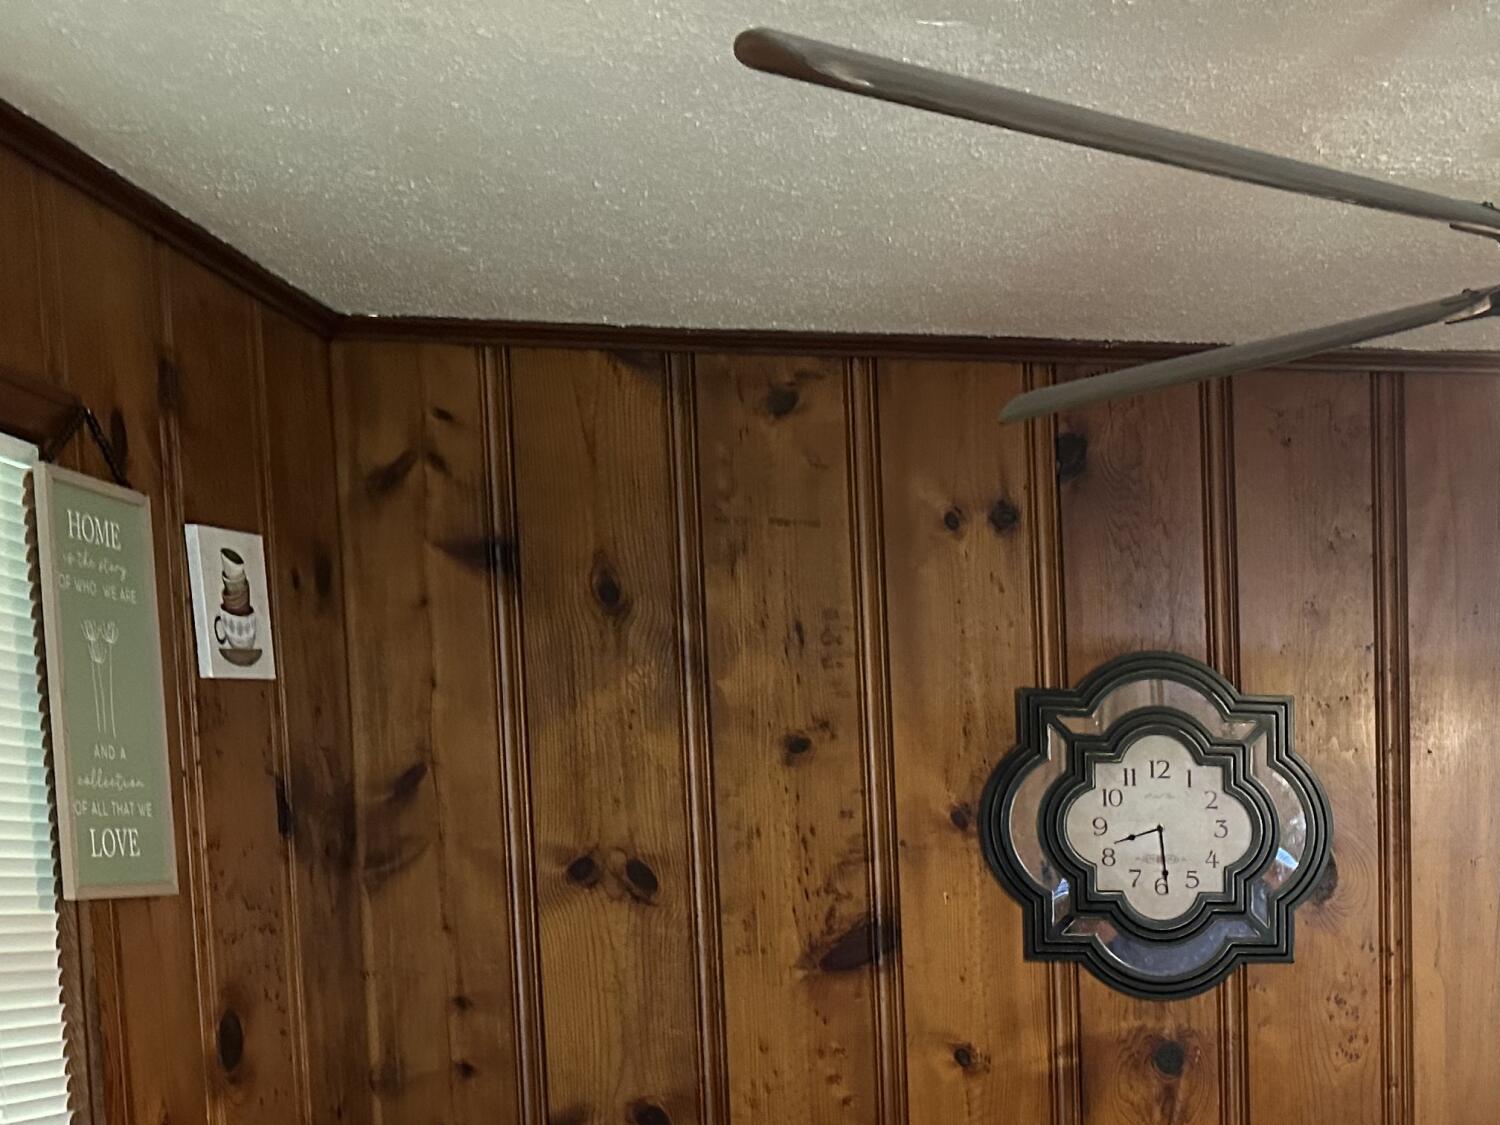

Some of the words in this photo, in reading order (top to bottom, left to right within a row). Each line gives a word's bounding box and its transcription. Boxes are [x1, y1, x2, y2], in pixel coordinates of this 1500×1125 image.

[67, 509, 121, 552] HOME
[60, 573, 71, 590] OF
[73, 577, 96, 597] WHO
[102, 585, 117, 601] WE
[120, 586, 137, 604] ARE
[94, 743, 116, 761] AND
[120, 747, 127, 761] A
[1123, 768, 1137, 787] 11
[1149, 760, 1171, 779] 12
[1186, 769, 1192, 788] 1
[1102, 788, 1123, 807] 10
[1204, 791, 1218, 810] 2
[75, 799, 88, 816] OF
[92, 801, 109, 817] ALL
[112, 801, 134, 817] THAT
[137, 802, 153, 818] WE
[1092, 817, 1108, 836] 9
[1214, 819, 1228, 839] 3
[89, 828, 141, 858] LOVE
[1101, 848, 1116, 866] 8
[1205, 850, 1220, 869] 4
[1128, 869, 1142, 888] 7
[1154, 877, 1169, 896] 6
[1185, 870, 1200, 889] 5
